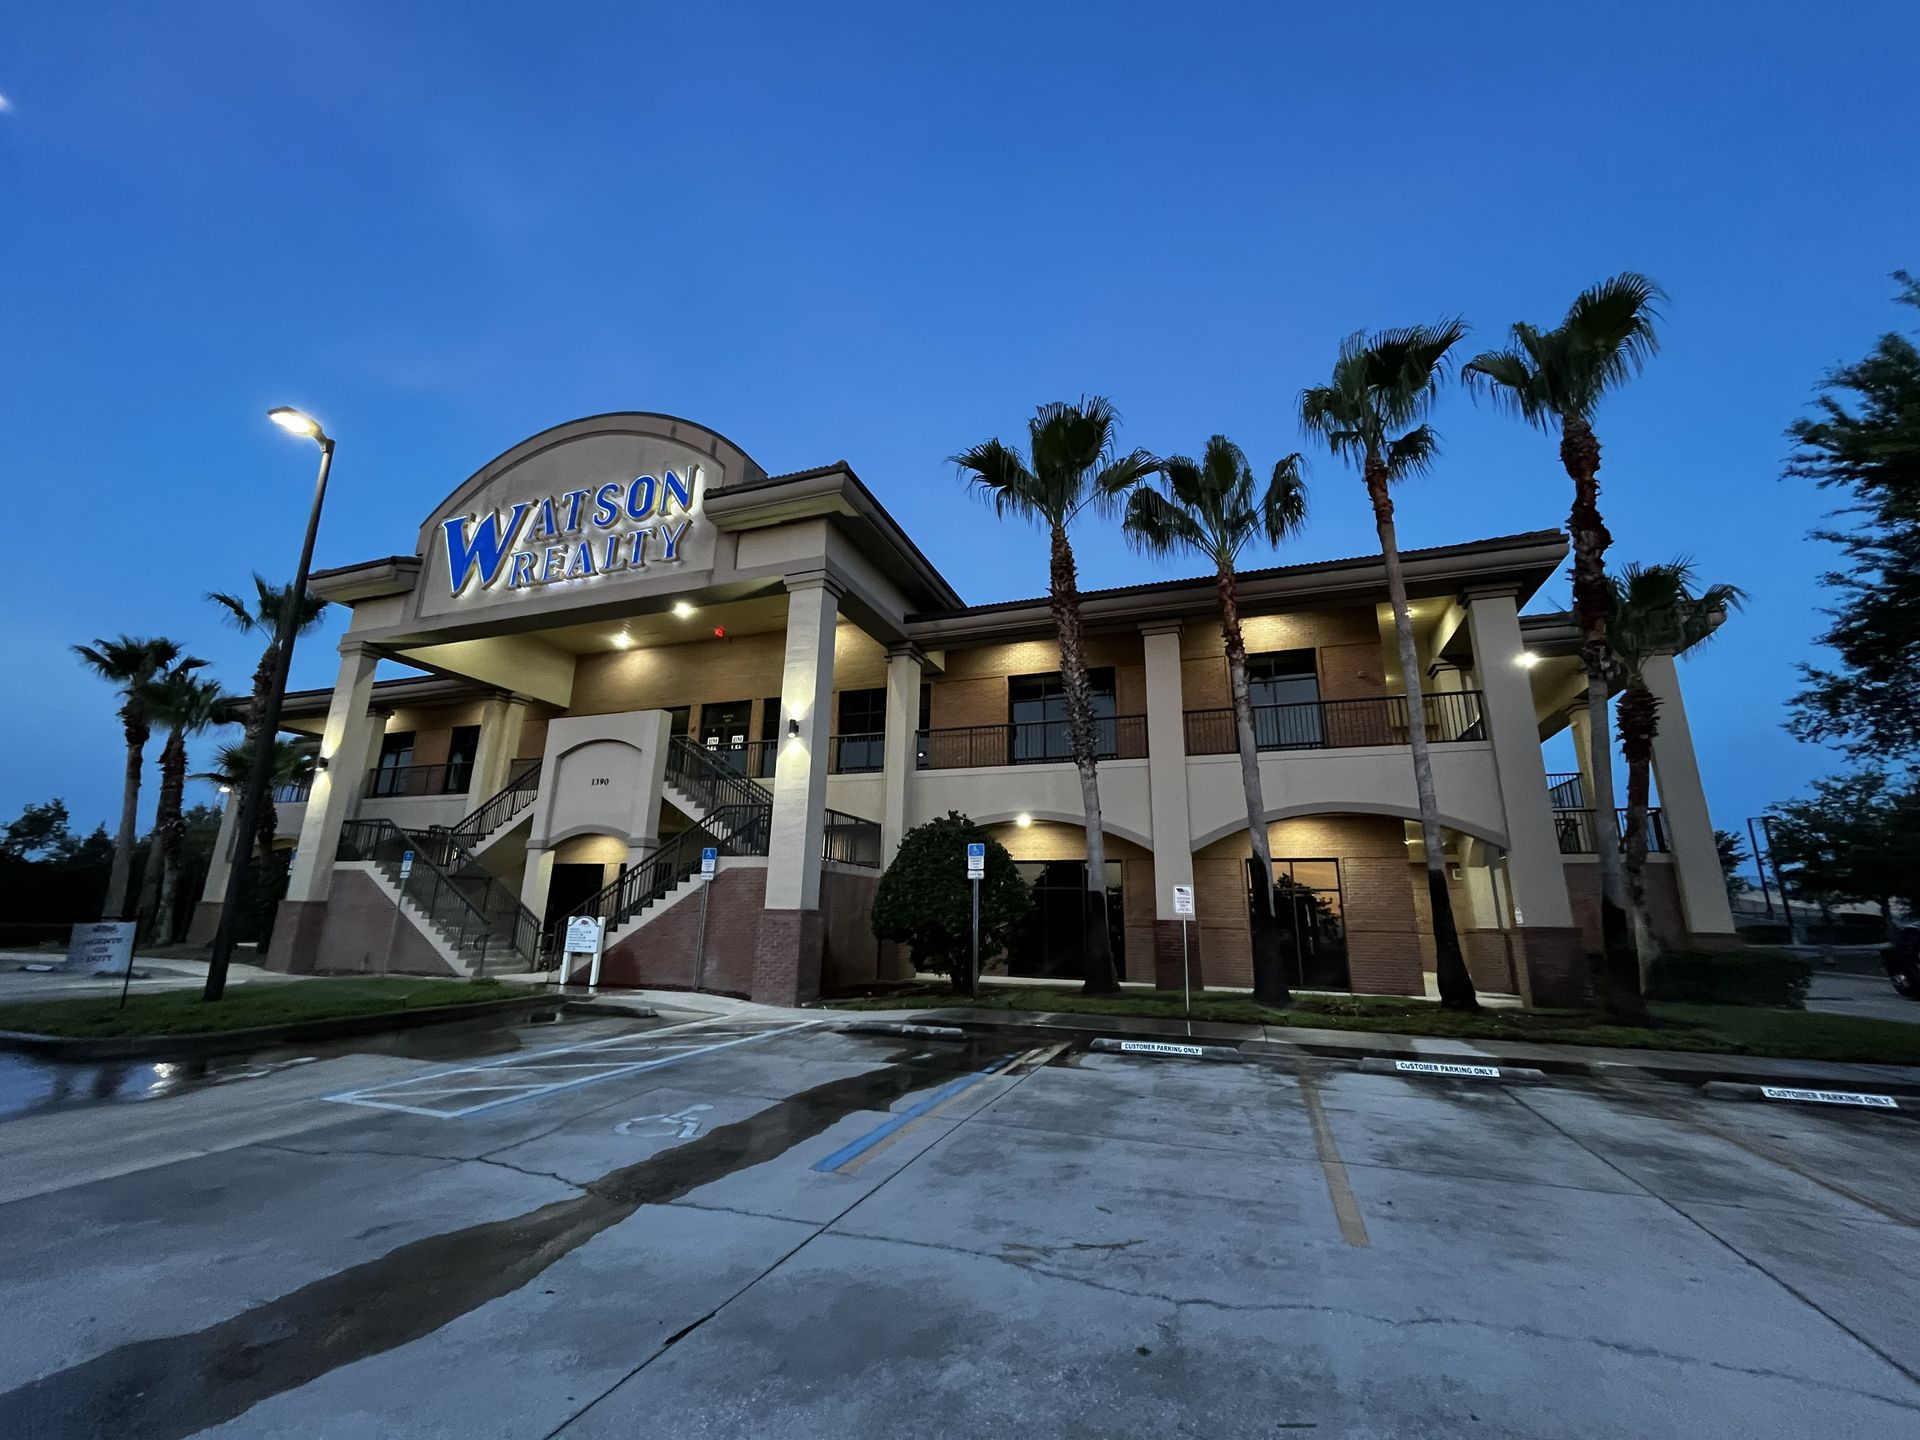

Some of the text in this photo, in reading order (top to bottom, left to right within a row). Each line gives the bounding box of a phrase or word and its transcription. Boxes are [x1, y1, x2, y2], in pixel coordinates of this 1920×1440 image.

[441, 463, 699, 598] WATSON
[507, 520, 692, 590] REALTY
[1124, 1043, 1200, 1054] CUSTOMER PARKING ONLY
[1400, 1062, 1494, 1076] CUSTOMER PARKING ONLY
[1768, 1089, 1891, 1105] CUSTOMER PARKING ONLY
